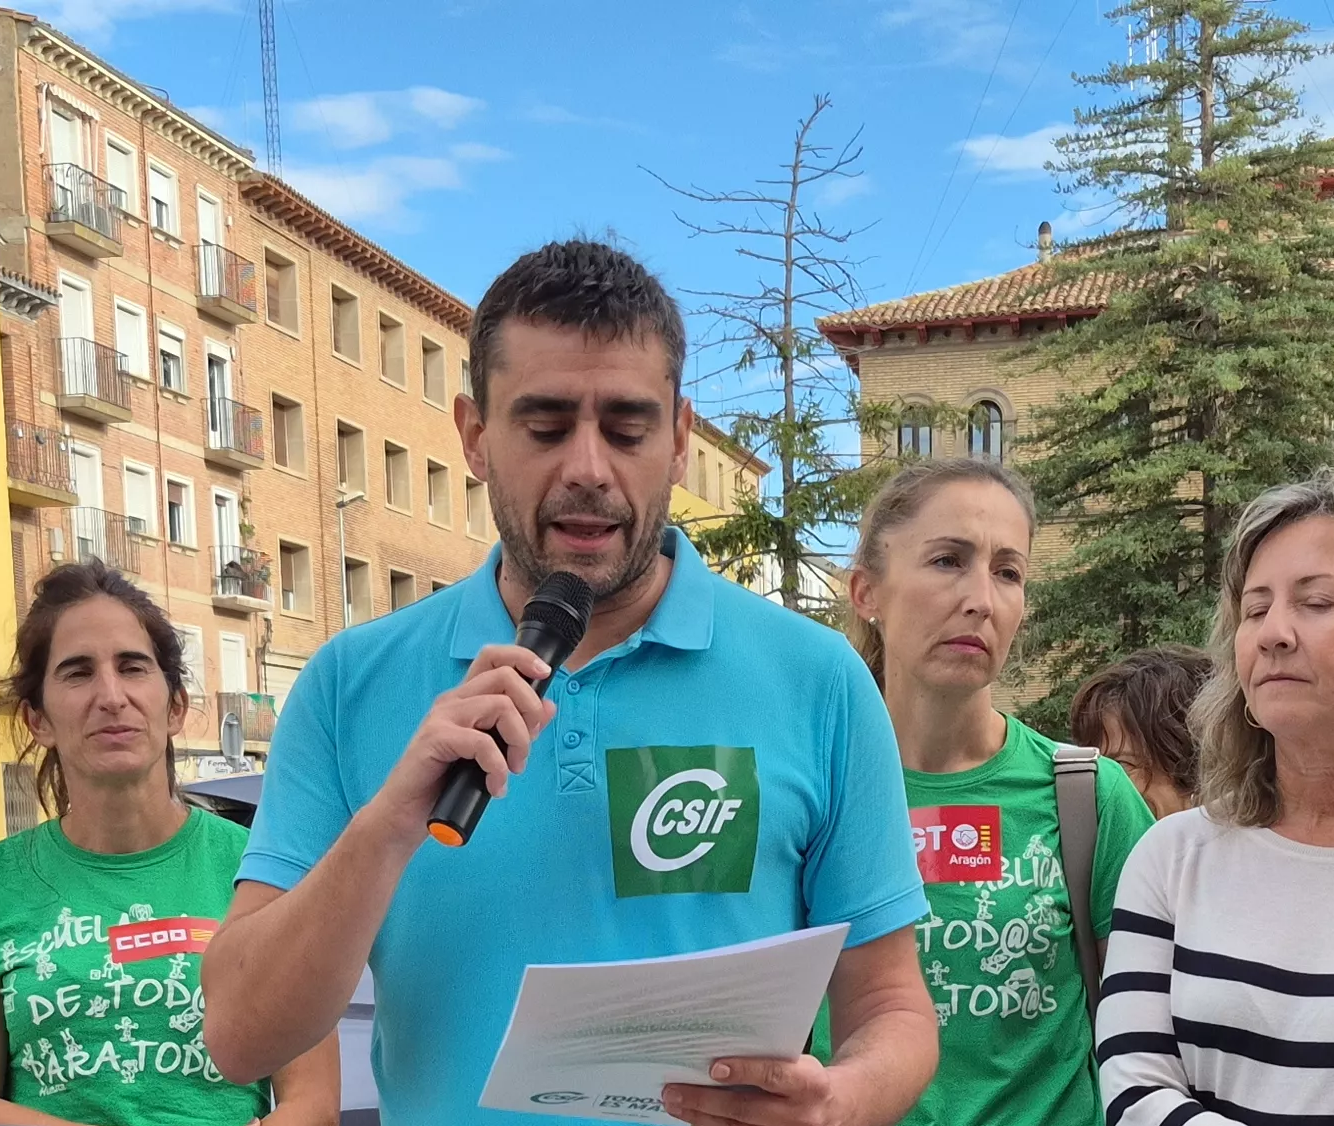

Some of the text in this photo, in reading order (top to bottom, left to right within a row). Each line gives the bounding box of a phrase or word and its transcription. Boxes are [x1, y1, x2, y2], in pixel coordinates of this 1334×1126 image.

[653, 799, 743, 837] CSIF
[949, 854, 992, 868] Aragón
[4, 912, 129, 968] ESCUEL
[116, 929, 187, 951] CCOO
[915, 918, 1052, 958] TOD@S
[27, 984, 82, 1026] DE
[943, 984, 1058, 1019] TOD@S
[28, 1040, 122, 1086] PARA
